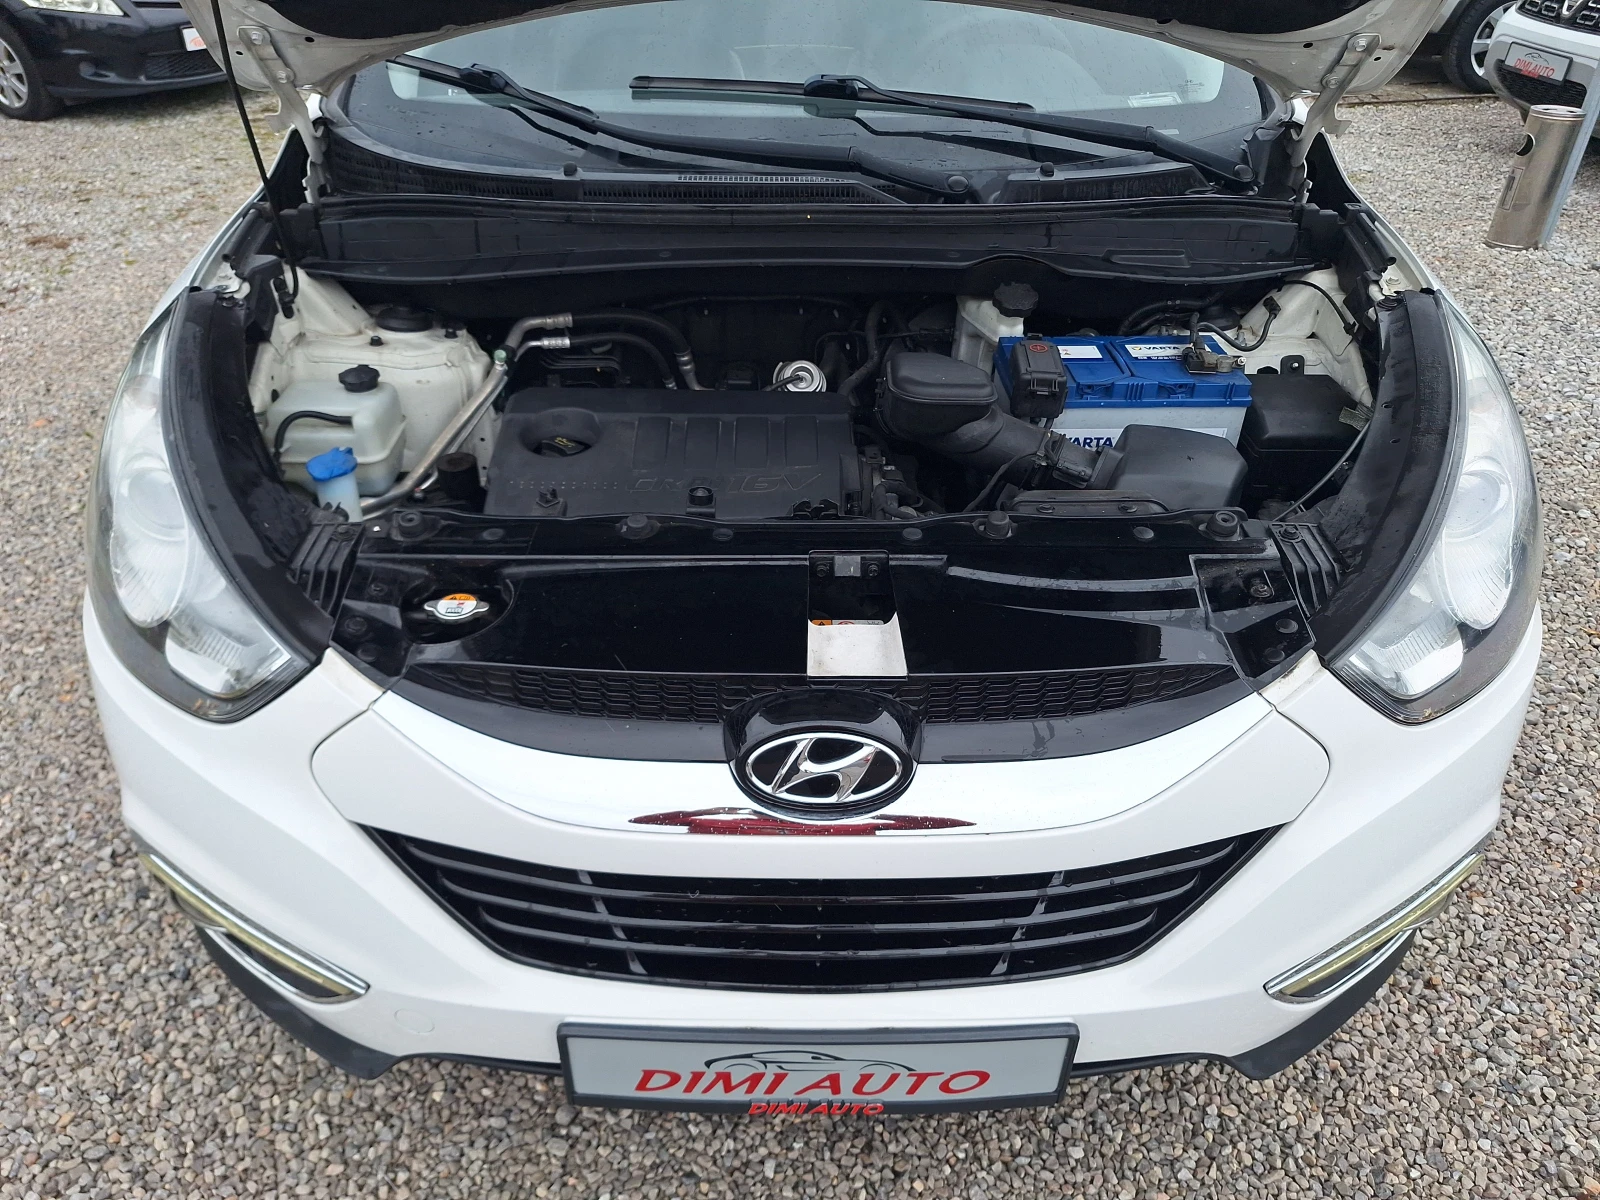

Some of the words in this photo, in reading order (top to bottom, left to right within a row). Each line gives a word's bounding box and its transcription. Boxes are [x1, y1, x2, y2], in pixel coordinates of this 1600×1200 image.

[1513, 58, 1533, 71] DIMI
[1532, 64, 1555, 78] AUTO
[634, 1069, 789, 1095] DIMI
[794, 1070, 990, 1096] AUTO
[748, 1102, 808, 1115] DIMI
[809, 1102, 885, 1115] AUTO
